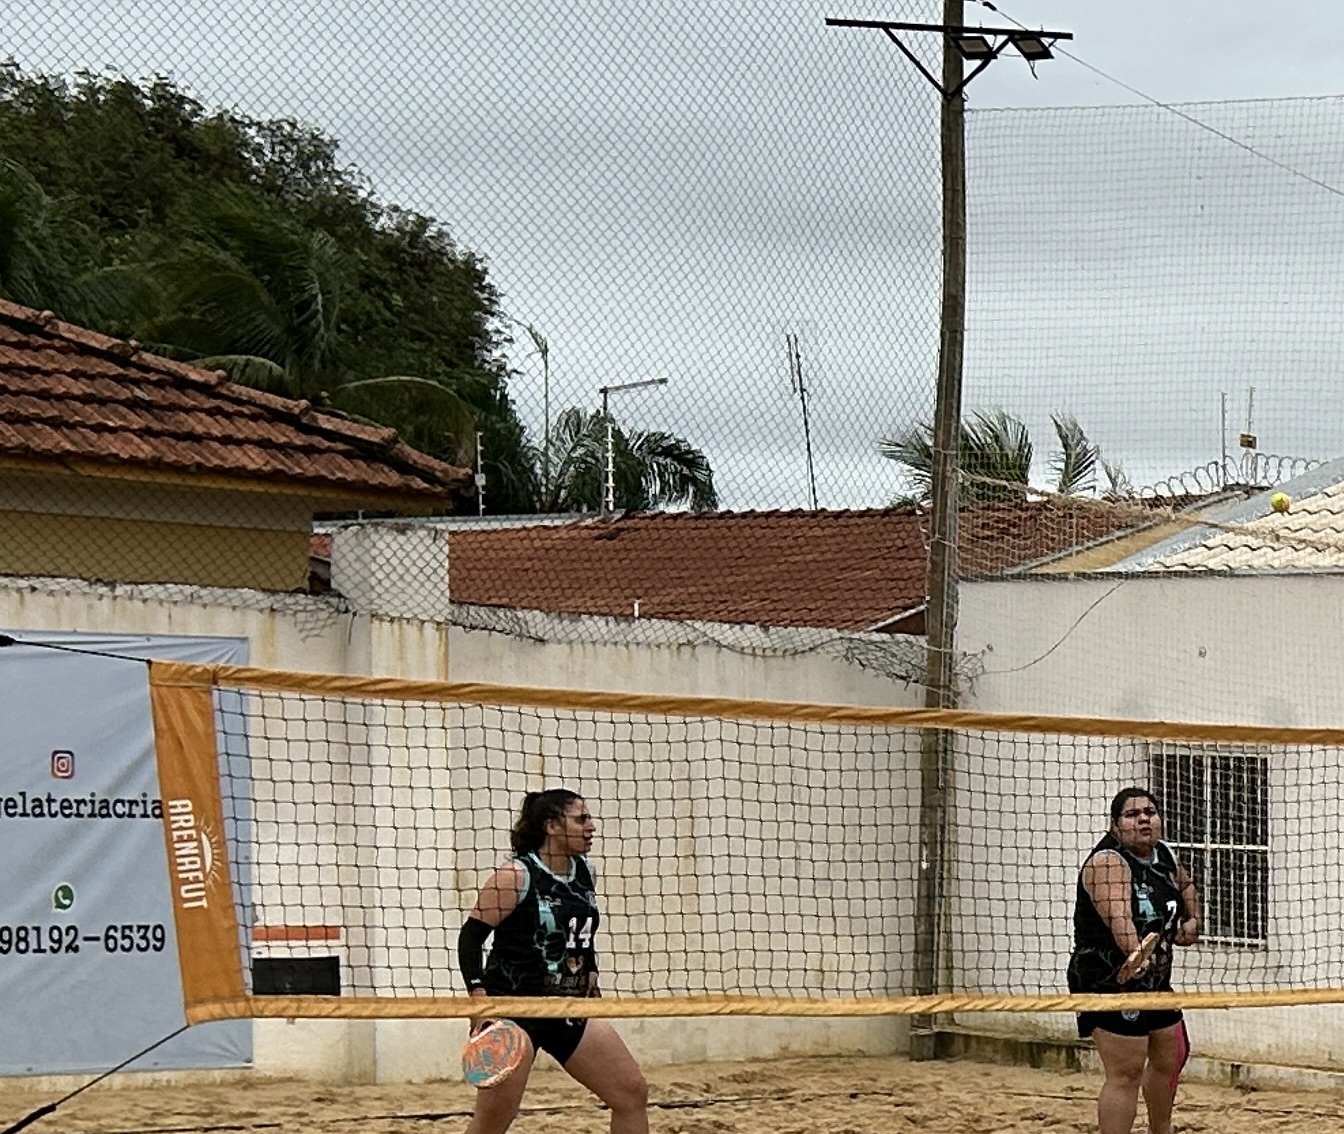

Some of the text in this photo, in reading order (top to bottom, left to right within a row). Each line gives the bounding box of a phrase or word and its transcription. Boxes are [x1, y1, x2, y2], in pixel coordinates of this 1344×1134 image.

[0, 791, 164, 819] elateriacria
[168, 799, 208, 909] ARENAFUT
[0, 923, 166, 954] 98192-6539
[566, 916, 593, 949] 14
